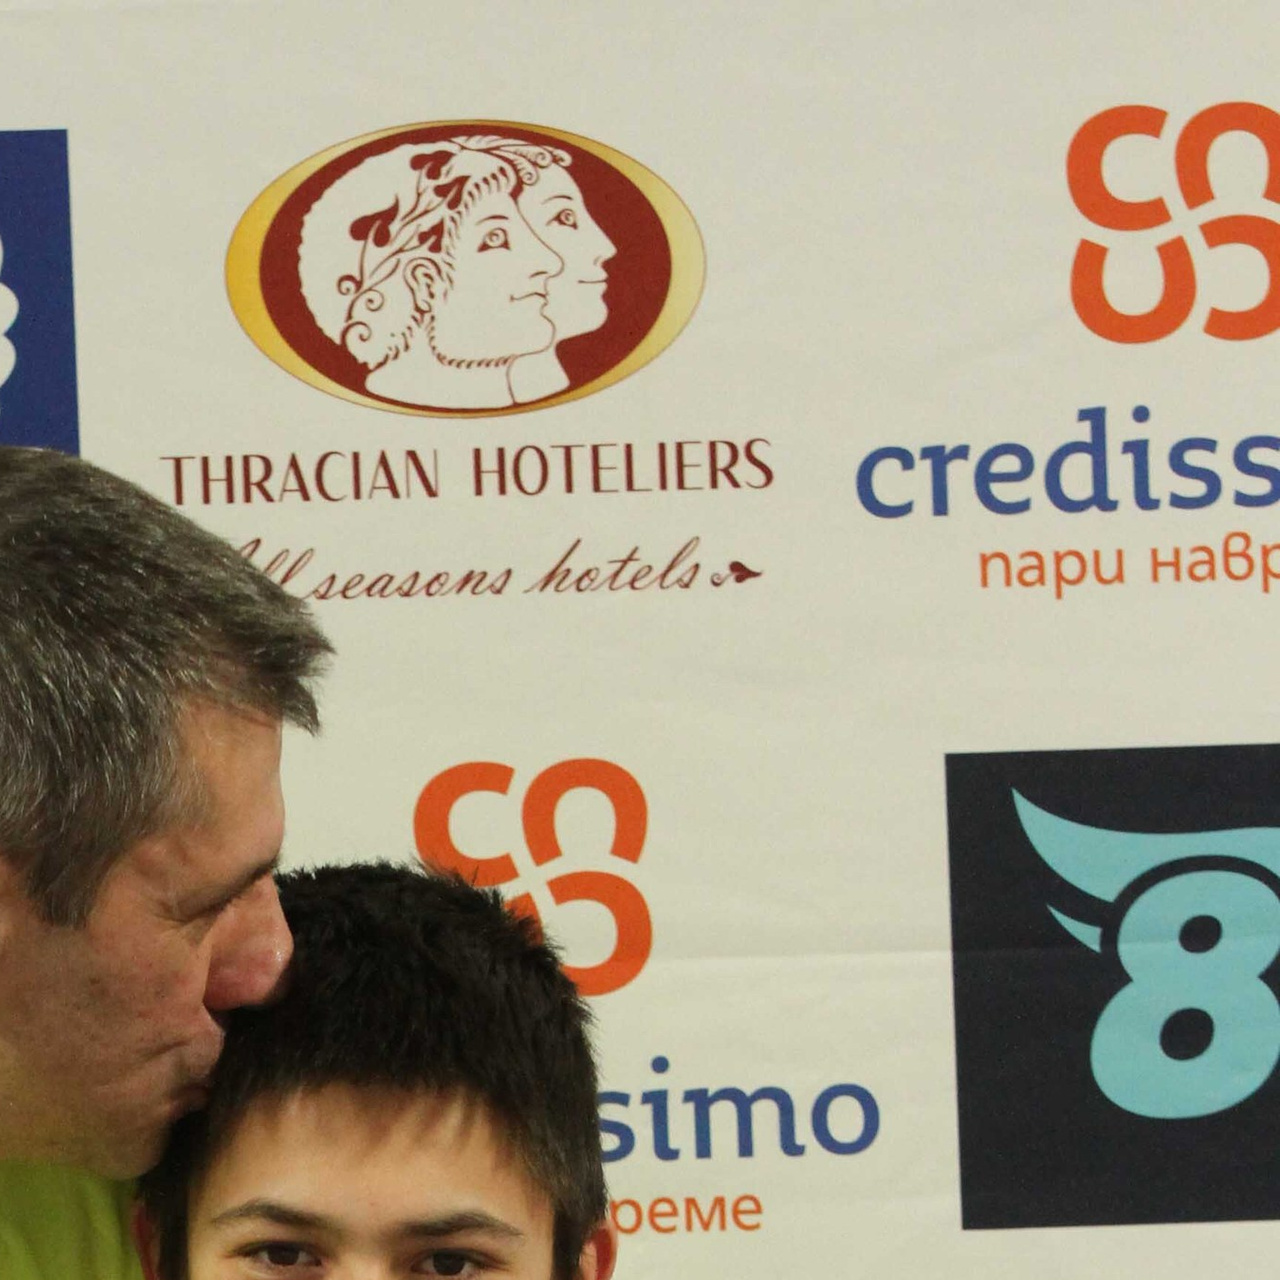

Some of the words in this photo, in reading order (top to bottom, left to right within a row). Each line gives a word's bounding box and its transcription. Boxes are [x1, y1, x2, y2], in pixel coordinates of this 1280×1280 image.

[160, 449, 439, 506] THRACIAN
[472, 438, 775, 496] HOTELIERS
[856, 404, 1280, 519] crediss
[302, 560, 513, 600] seasons
[524, 535, 701, 595] hotels
